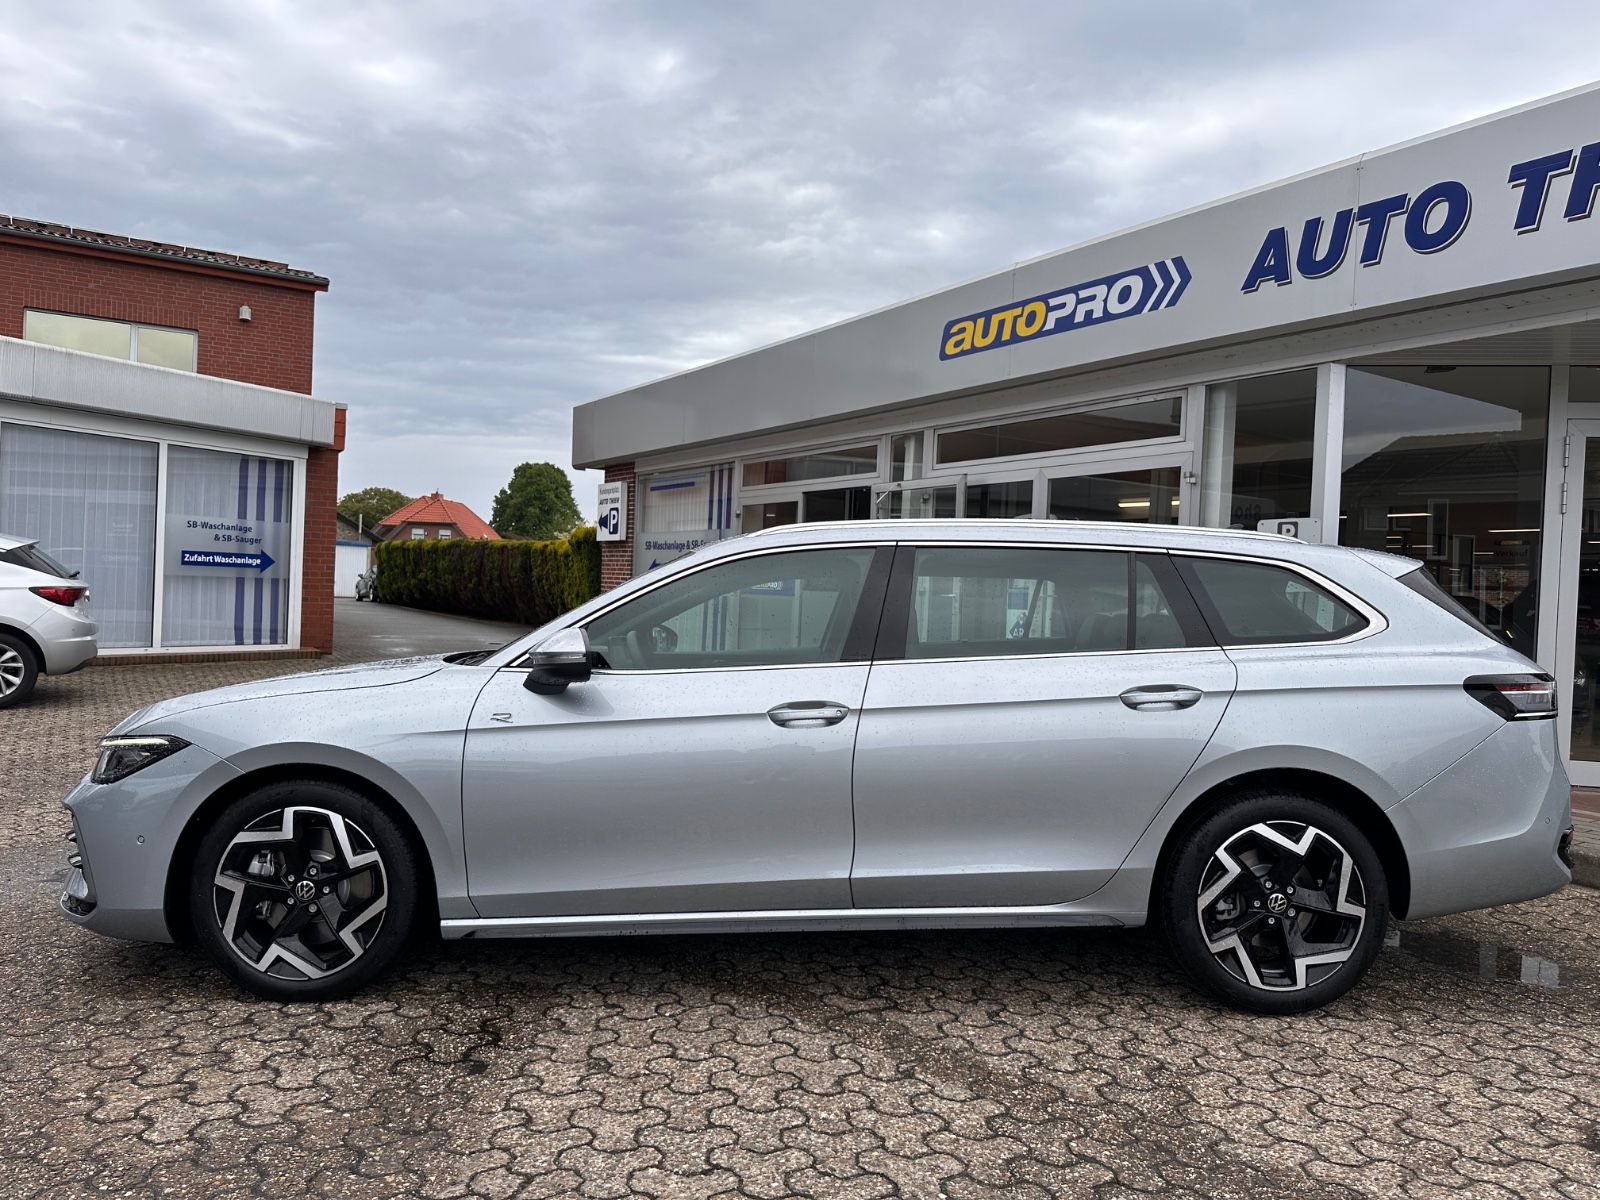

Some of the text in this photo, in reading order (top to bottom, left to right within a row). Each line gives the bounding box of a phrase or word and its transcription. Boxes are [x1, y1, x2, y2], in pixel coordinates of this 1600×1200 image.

[1241, 179, 1472, 294] AUTO
[187, 520, 253, 533] SB-Waschanlage
[222, 534, 262, 545] SB-Sauger
[184, 554, 262, 566] Zufahrt Waschanlage
